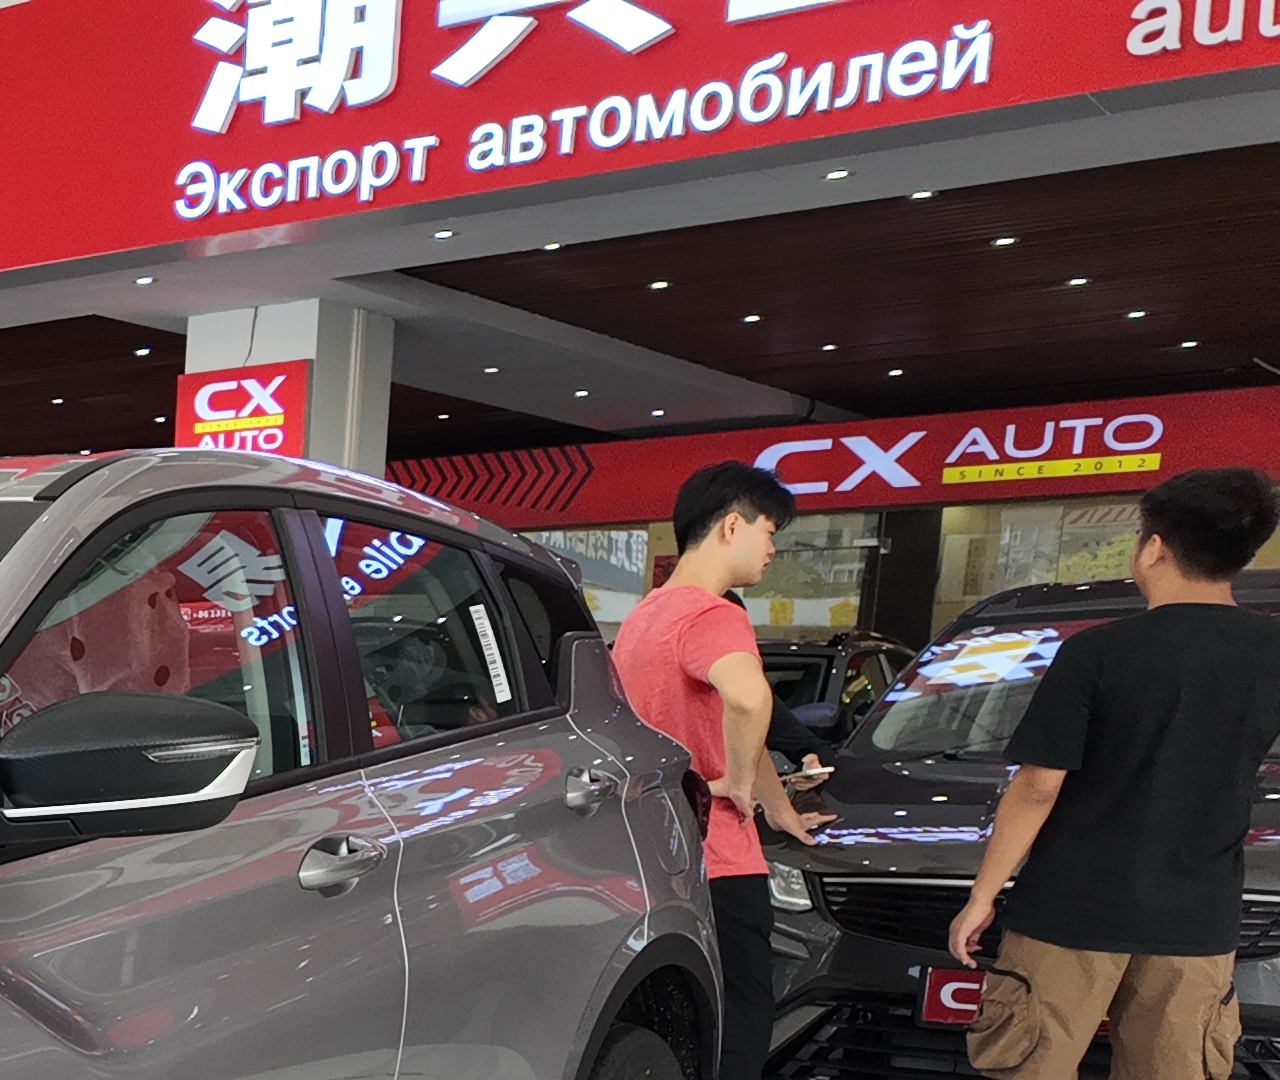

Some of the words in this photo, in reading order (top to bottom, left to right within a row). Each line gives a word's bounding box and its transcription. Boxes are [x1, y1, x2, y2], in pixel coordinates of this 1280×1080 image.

[1126, 0, 1280, 56] au
[174, 135, 439, 219] Экспорт
[467, 19, 993, 170] автомобилей
[194, 375, 287, 420] CX
[198, 428, 284, 451] AUTO
[753, 430, 927, 495] CX
[944, 413, 1164, 463] AUTO
[958, 465, 1045, 481] SINCE
[1073, 457, 1148, 474] 2012
[940, 981, 980, 1011] C
